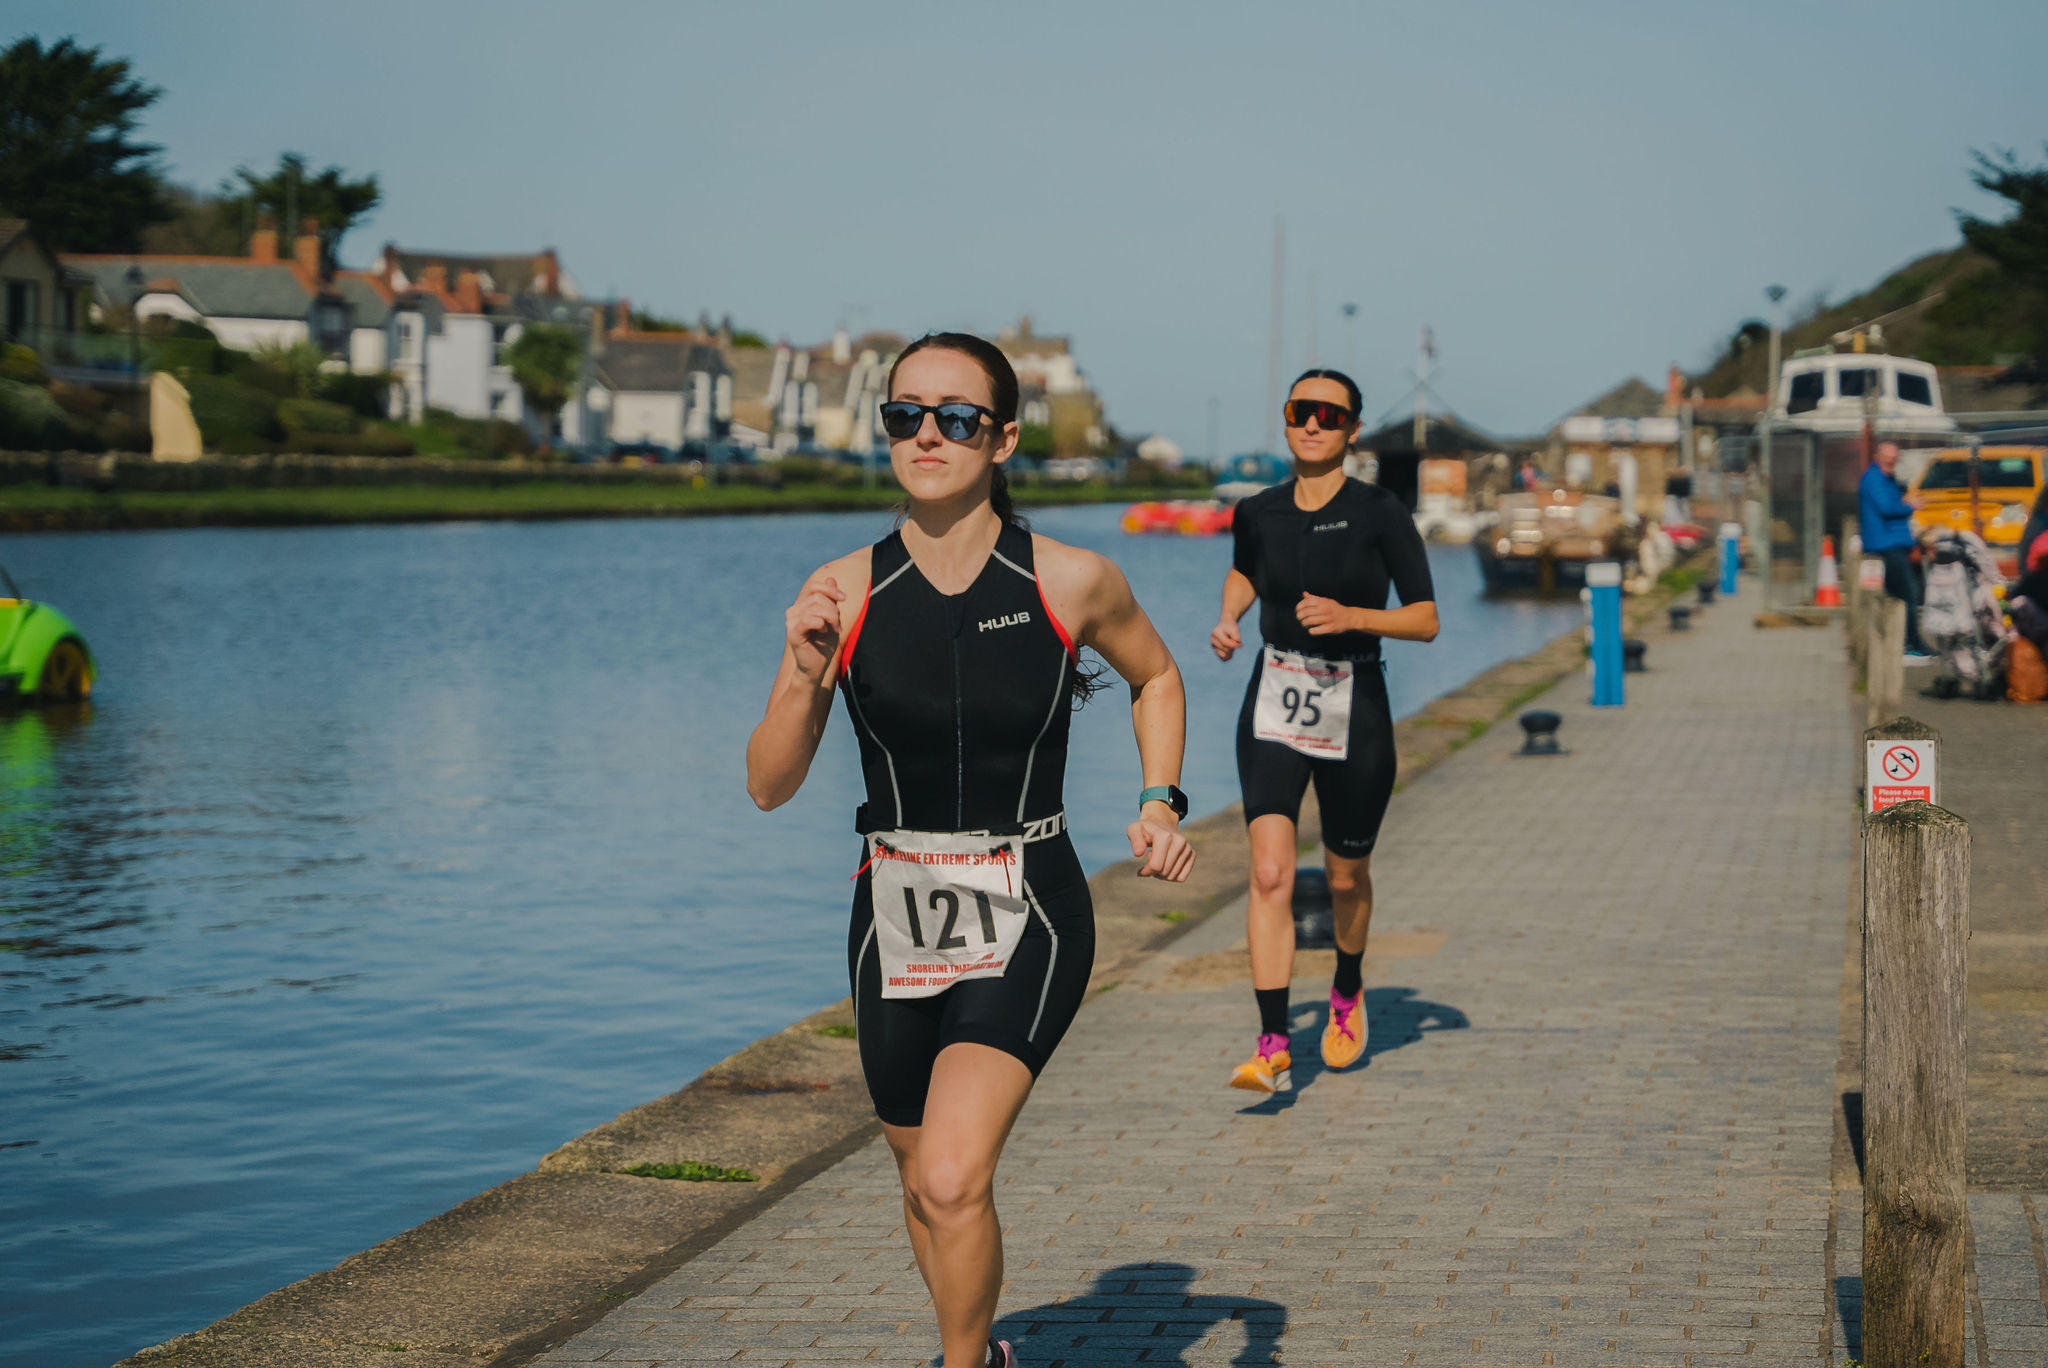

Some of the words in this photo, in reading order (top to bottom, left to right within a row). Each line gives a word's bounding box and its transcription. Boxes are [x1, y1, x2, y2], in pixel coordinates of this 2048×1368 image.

[978, 611, 1031, 633] HUUB
[1282, 686, 1322, 727] 95
[923, 853, 970, 865] EXTREME
[903, 886, 997, 950] 121
[906, 963, 948, 973] SHORELINE
[888, 977, 926, 987] AWESOME
